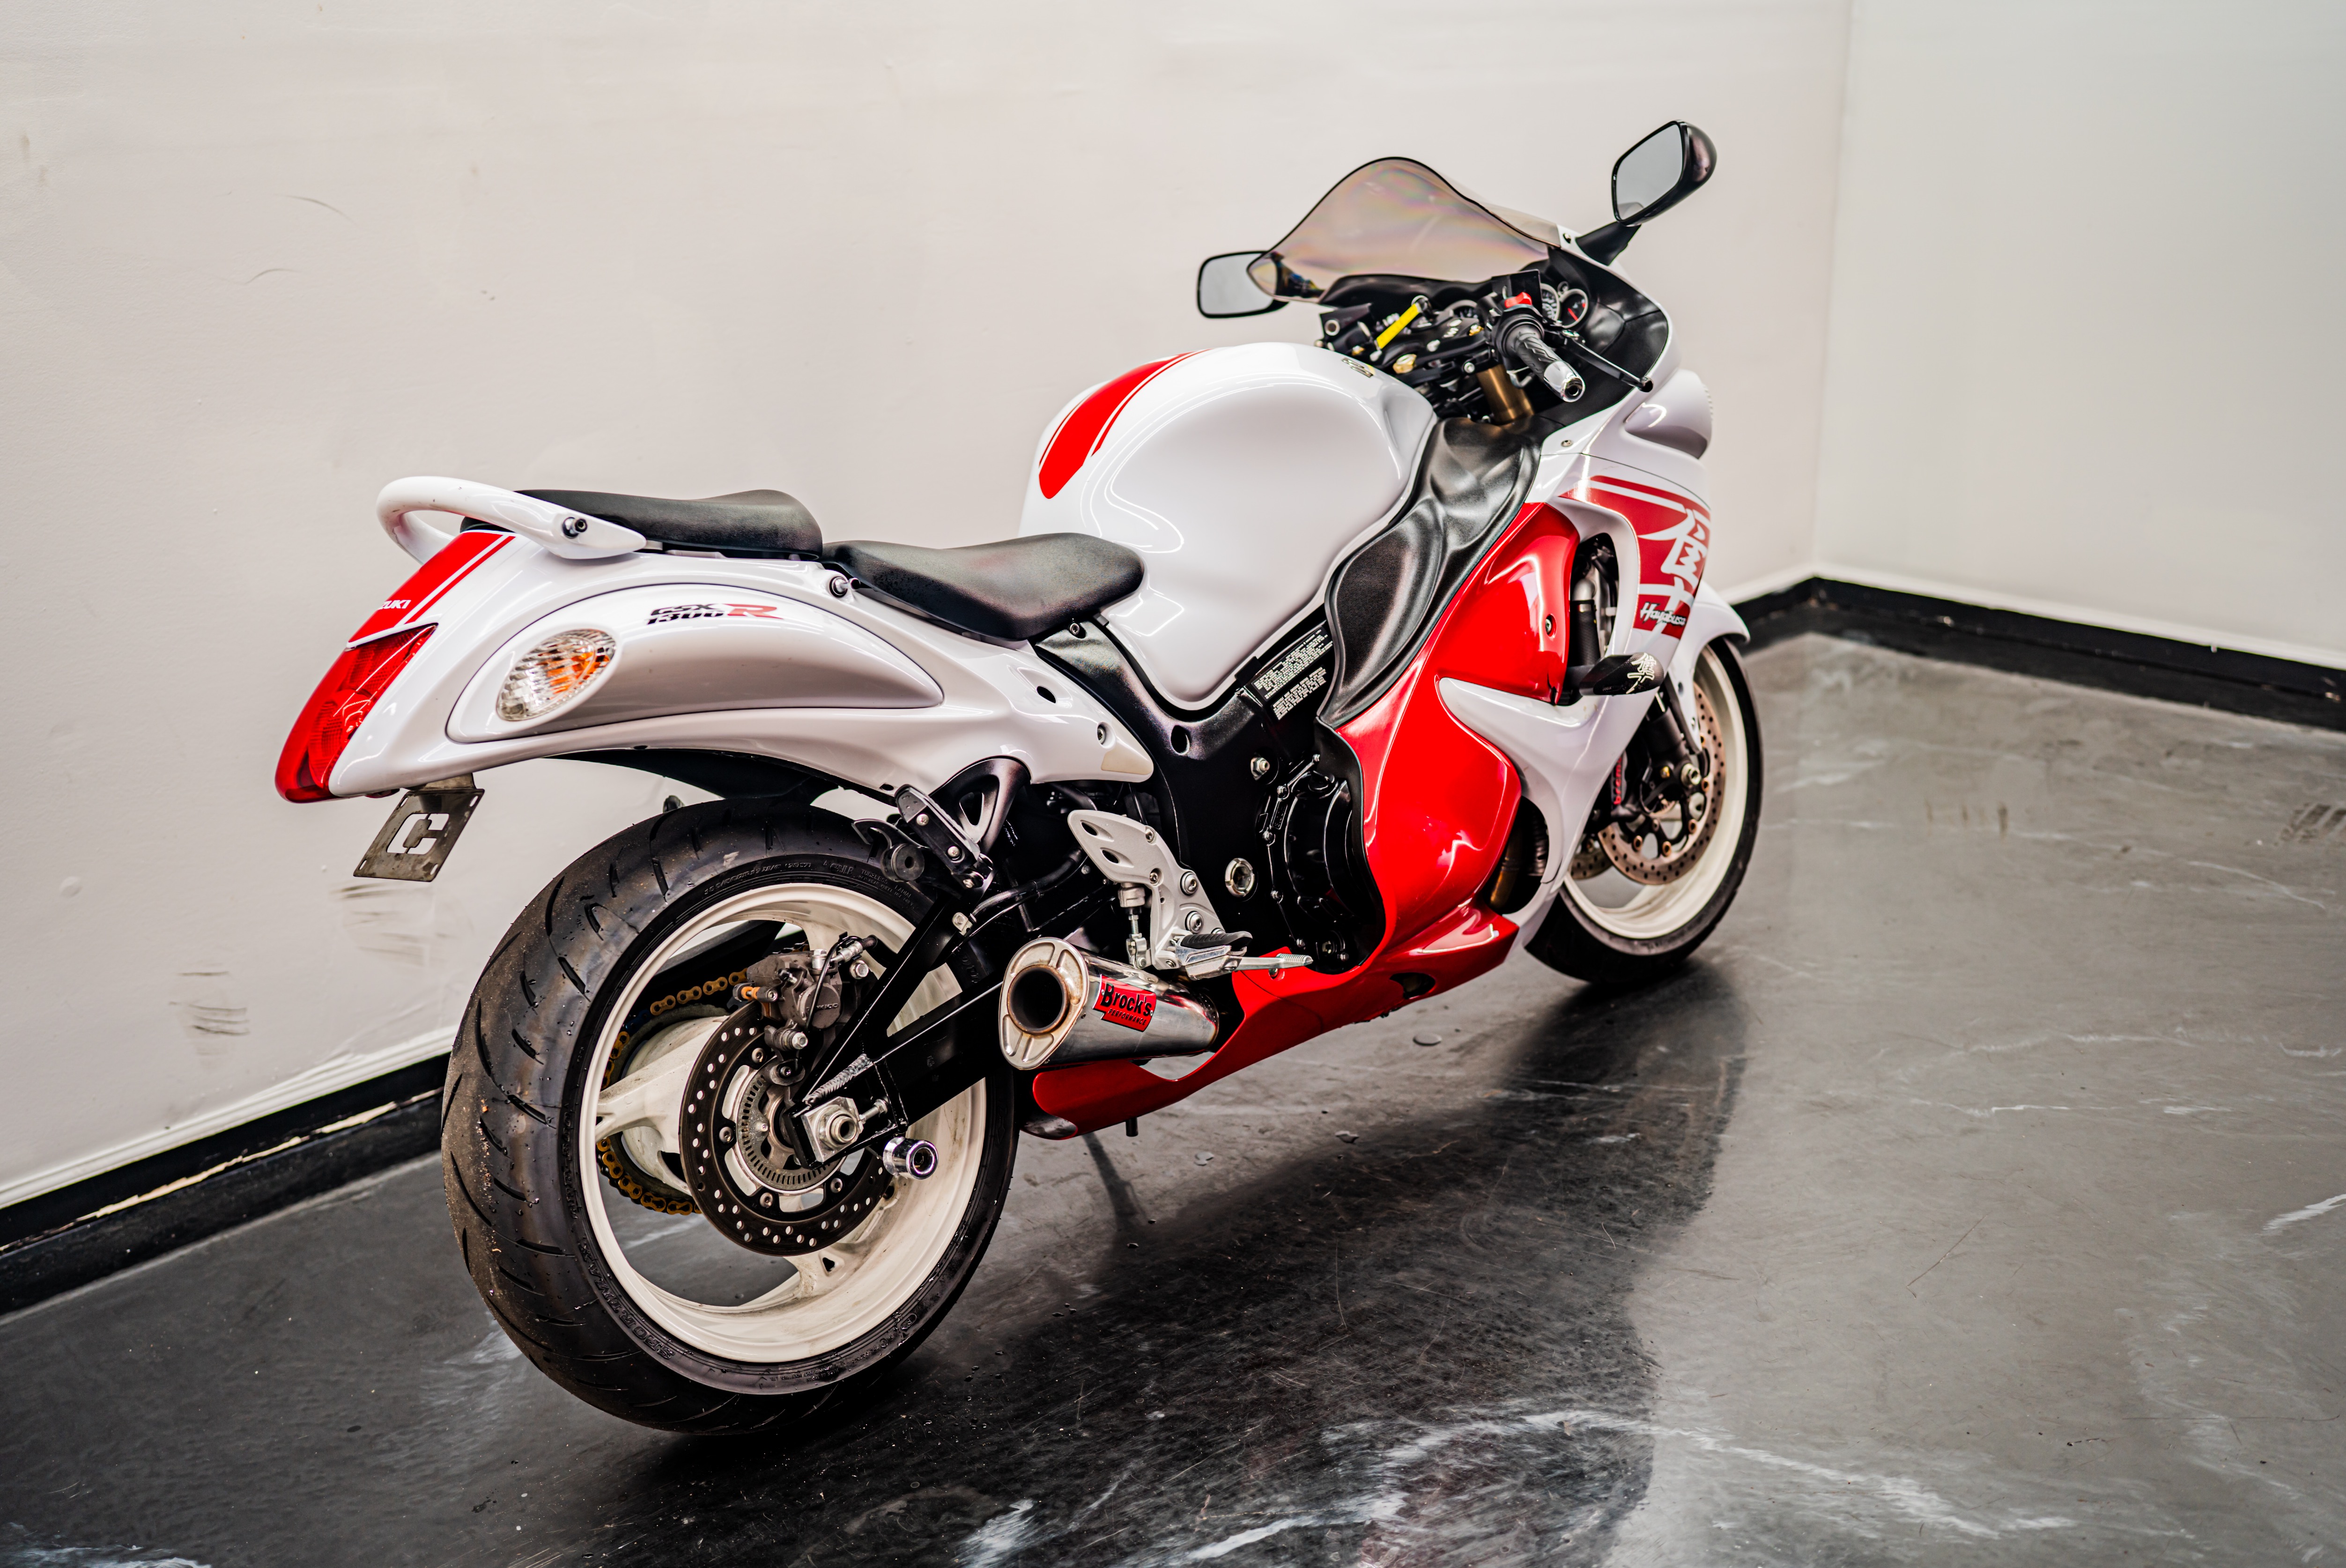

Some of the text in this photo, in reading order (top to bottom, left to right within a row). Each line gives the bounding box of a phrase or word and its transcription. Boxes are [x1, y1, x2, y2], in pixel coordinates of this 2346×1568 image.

[377, 599, 412, 610] ZUKI
[1639, 601, 1687, 627] Hayabusa
[1613, 756, 1622, 805] brem
[861, 869, 888, 885] TUBELESS
[806, 1003, 838, 1012] TKICO
[1101, 983, 1153, 1017] Brock's
[1107, 1008, 1147, 1026] PERFORMANCE
[577, 1243, 676, 1360] SPORTMAX
